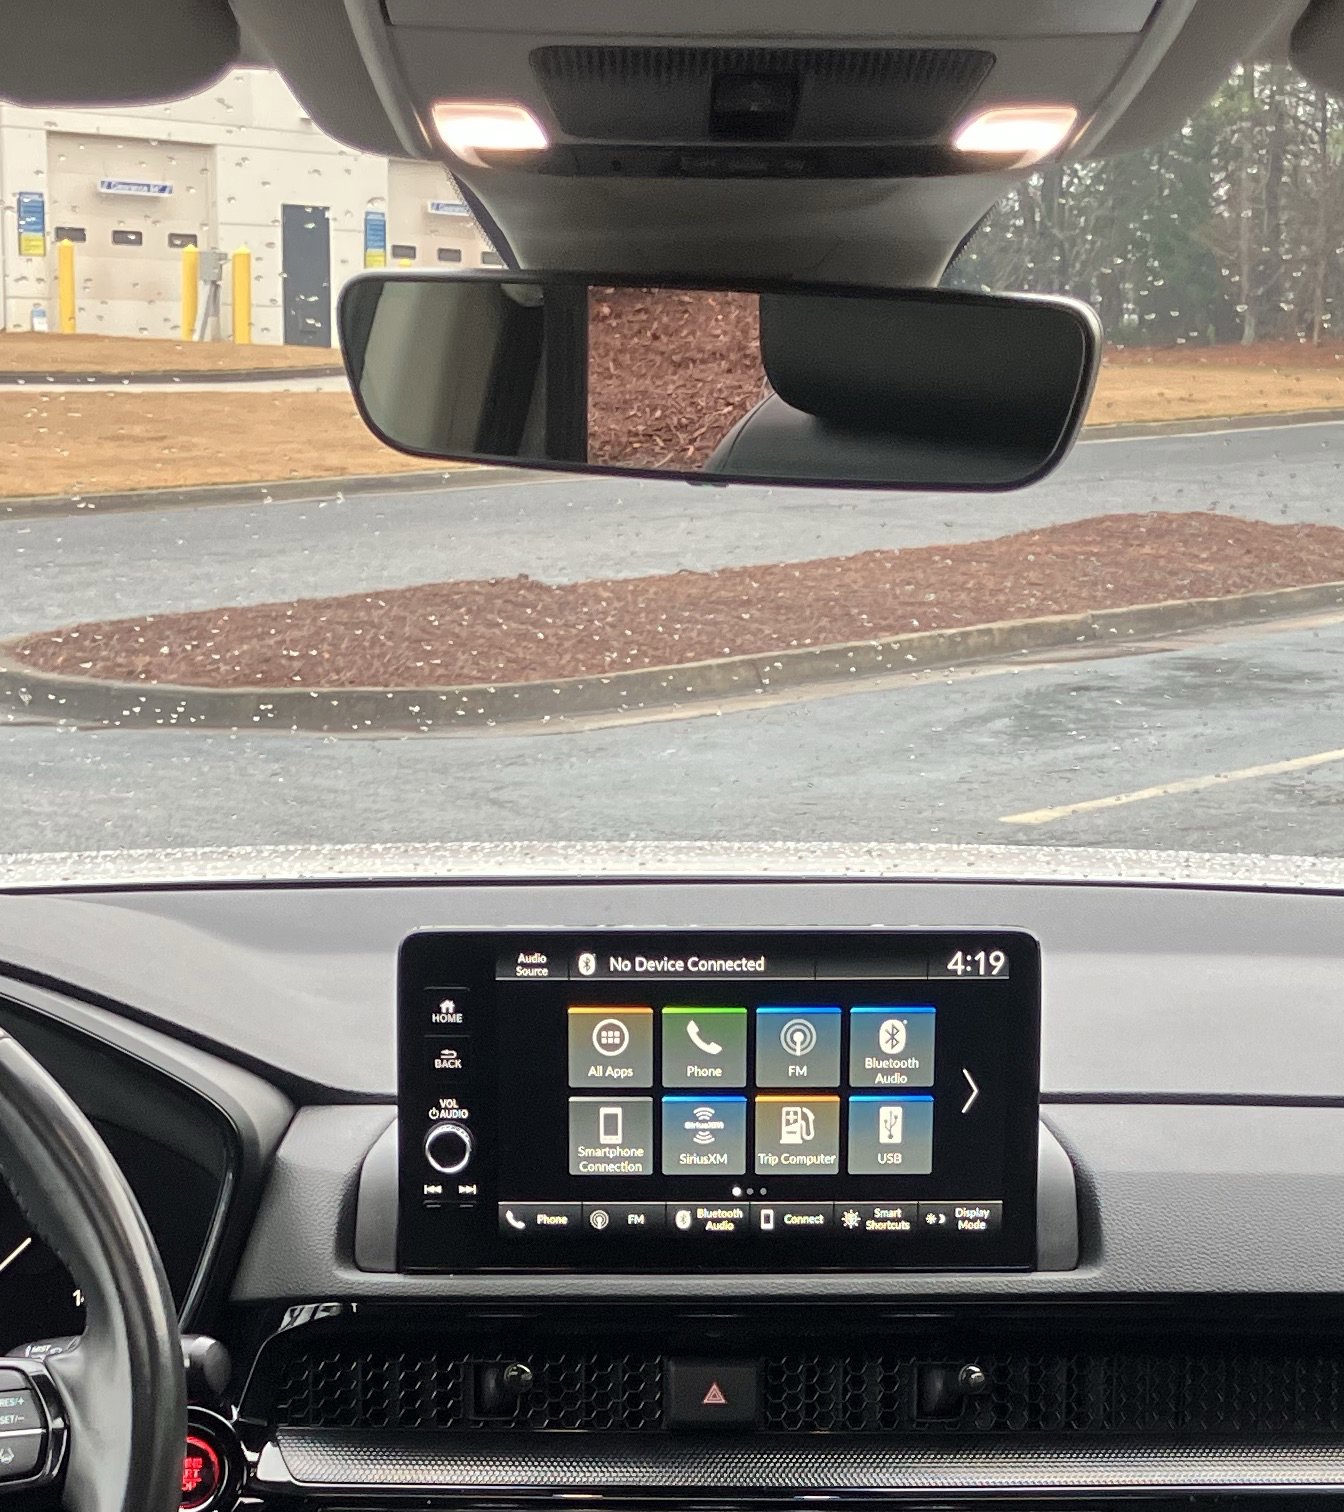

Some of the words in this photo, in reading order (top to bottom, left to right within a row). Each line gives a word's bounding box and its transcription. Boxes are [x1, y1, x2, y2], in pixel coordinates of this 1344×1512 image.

[517, 953, 547, 964] Audio
[609, 957, 631, 972] No
[634, 956, 684, 972] Device
[687, 956, 765, 972] Connected
[947, 951, 1005, 976] 4:19
[516, 966, 548, 977] Source
[432, 1013, 463, 1023] HOME
[435, 1059, 462, 1069] BACK
[865, 1057, 920, 1069] Bluetooth
[588, 1066, 603, 1077] All
[605, 1066, 634, 1079] Apps
[687, 1066, 723, 1077] Phone
[788, 1066, 807, 1077] FM
[875, 1072, 907, 1085] Audio
[439, 1099, 459, 1109] VOL
[439, 1109, 469, 1119] AUDIO
[577, 1146, 644, 1159] Smartphone
[679, 1154, 728, 1166] SiriusXM
[758, 1154, 778, 1167] Trip
[781, 1154, 837, 1167] Computer
[877, 1154, 903, 1165] USB
[579, 1161, 643, 1173] Connection
[696, 1208, 743, 1219] Bluetooth
[874, 1208, 903, 1219] Smart
[955, 1208, 990, 1220] Display
[536, 1214, 568, 1225] Phone
[628, 1214, 645, 1225] FM
[784, 1214, 824, 1225] Connect
[958, 1219, 987, 1230] Mode
[706, 1221, 734, 1231] Audio
[865, 1220, 911, 1231] Shortcuts
